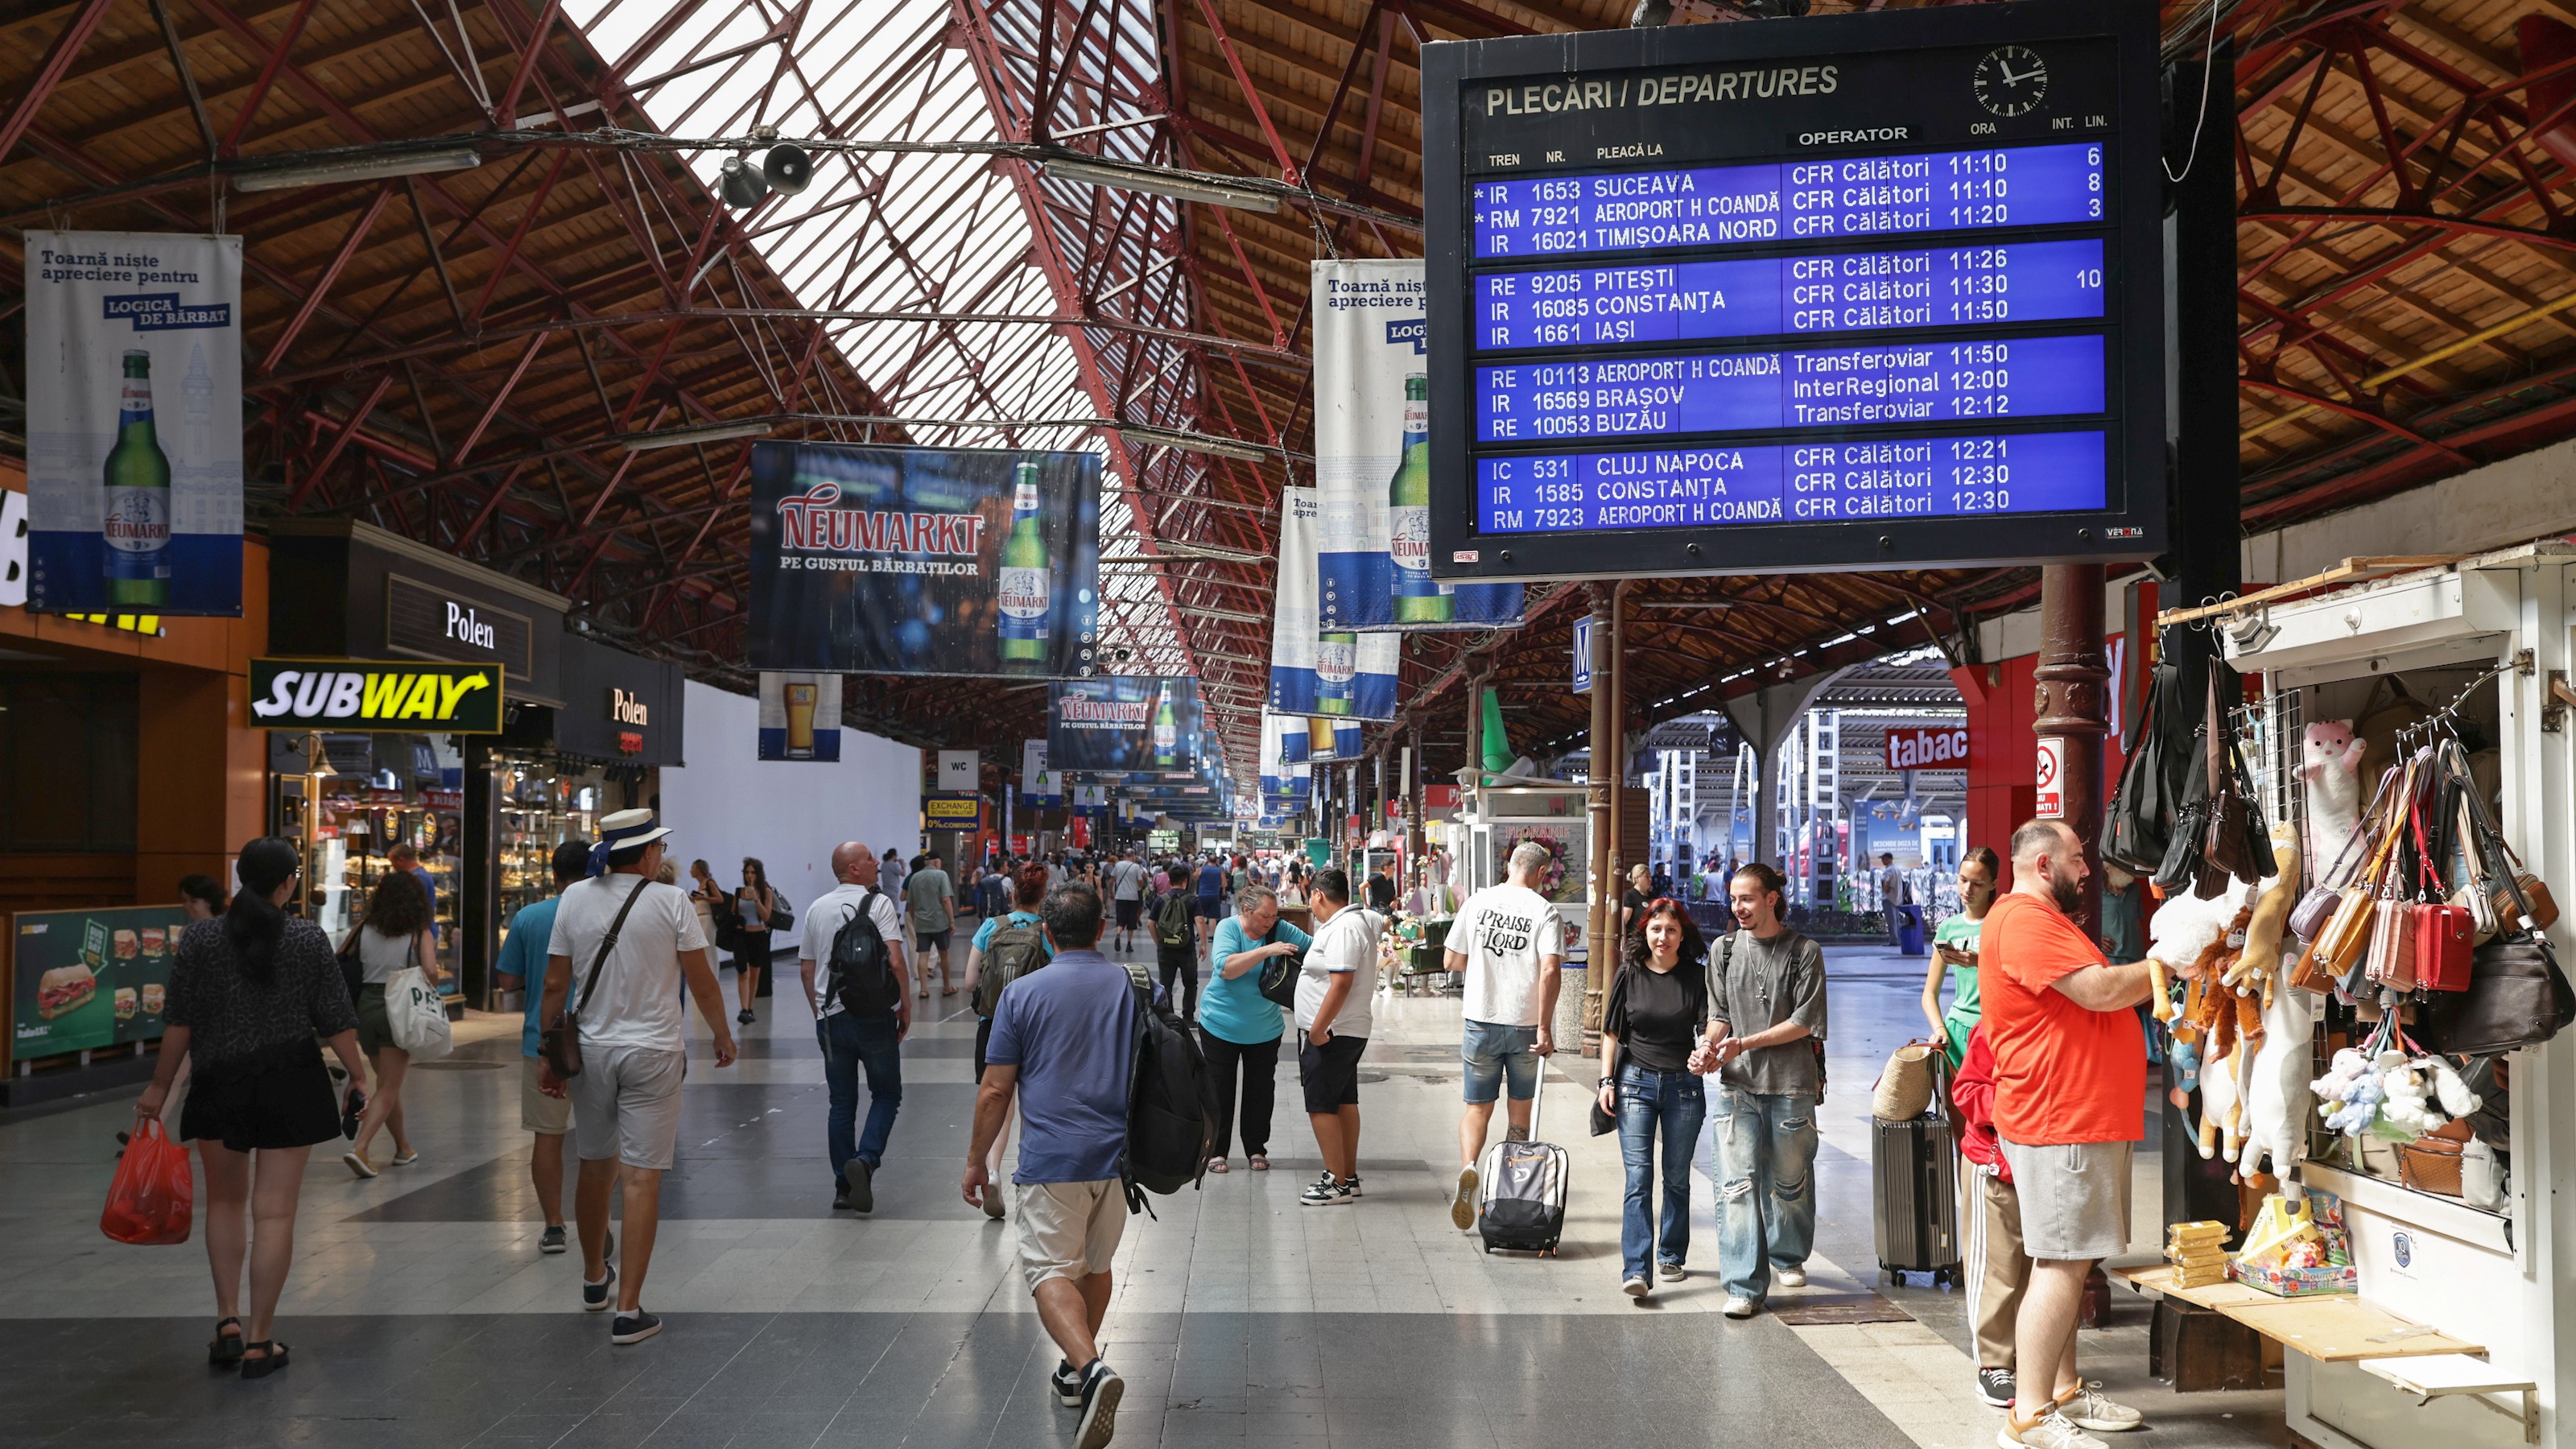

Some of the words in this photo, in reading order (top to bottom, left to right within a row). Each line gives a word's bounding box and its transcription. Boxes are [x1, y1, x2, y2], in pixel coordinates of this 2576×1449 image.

[1488, 76, 1611, 116] PLECĂRI
[1638, 66, 1838, 106] DEPARTURES
[1799, 126, 1908, 146] OPERATOR
[1971, 122, 1996, 134] ORA
[2052, 118, 2074, 130] INT.
[2085, 115, 2107, 127] LIN.
[1489, 154, 1520, 166] TREN
[1546, 151, 1566, 163] NR.
[1597, 142, 1644, 159] PLEACĂ
[1648, 143, 1663, 156] LA
[1490, 186, 1508, 204] IR
[1531, 180, 1581, 202] 1653
[1595, 174, 1695, 198] SUCEAVA
[1793, 164, 1834, 184] CFR
[1843, 158, 1930, 182] Călători
[1949, 153, 2007, 175] 11:10
[2087, 147, 2100, 166] 6
[1490, 210, 1520, 229] RM
[1531, 206, 1579, 227] 7921
[1595, 199, 1684, 222] AEROPORT
[1691, 198, 1701, 217] H
[1708, 192, 1780, 216] COANDĂ
[1793, 190, 1834, 210] CFR
[1843, 183, 1930, 207] Călători
[1950, 179, 2007, 200] 11:10
[2088, 172, 2100, 192] 8
[1491, 235, 1509, 254] IR
[1531, 229, 1587, 251] 16021
[1596, 222, 1711, 248] TIMIȘOARA
[1719, 218, 1777, 239] NORD
[1793, 215, 1835, 236] CFR
[1843, 208, 1930, 232] Călători
[1950, 204, 2008, 225] 11:20
[2088, 198, 2101, 217] 3
[41, 250, 108, 266] Toarnă
[114, 254, 159, 270] niște
[1491, 278, 1516, 296] RE
[1531, 274, 1581, 294] 9205
[1595, 268, 1674, 292] PITEȘTI
[1793, 259, 1834, 279] CFR
[1843, 252, 1930, 277] Călători
[1950, 249, 2007, 270] 11:26
[42, 267, 132, 283] apreciere
[137, 271, 199, 286] pentru
[1328, 279, 1390, 293] Toarnă
[1396, 279, 1426, 295] niș
[108, 299, 173, 313] LOGICA
[1329, 294, 1414, 311] apreciere
[1491, 303, 1509, 320] IR
[1532, 298, 1589, 319] 16085
[1596, 291, 1726, 316] CONSTANȚA
[1794, 284, 1835, 304] CFR
[1843, 277, 1930, 302] Călători
[1950, 274, 2008, 295] 11:30
[2076, 269, 2101, 289] 10
[140, 313, 163, 325] DE
[167, 309, 226, 324] BĂRBAT
[1391, 324, 1426, 338] LOG
[1492, 327, 1509, 345] IR
[1533, 324, 1580, 343] 1661
[1596, 320, 1635, 342] IAȘI
[1794, 309, 1835, 329] CFR
[1844, 303, 1930, 327] Călători
[1951, 299, 2008, 321] 11:50
[1492, 369, 1517, 388] RE
[1532, 365, 1589, 386] 10113
[1596, 361, 1685, 383] AEROPORT
[1692, 360, 1702, 378] H
[1709, 353, 1781, 378] COANDĂ
[1794, 348, 1933, 374] Transferoviar
[1951, 344, 2008, 365] 11:50
[1492, 394, 1509, 413] IR
[1533, 390, 1589, 411] 16569
[1596, 385, 1685, 408] BRAȘOV
[1794, 373, 1939, 398] InterRegional
[1951, 369, 2008, 390] 12:00
[1492, 419, 1517, 437] RE
[1533, 415, 1590, 436] 10053
[1596, 407, 1666, 432] BUZĂU
[1794, 398, 1934, 423] Transferoviar
[1951, 394, 2008, 416] 12:12
[1493, 461, 1511, 481] IC
[1534, 459, 1569, 478] 531
[1597, 455, 1647, 476] CLUJ
[1656, 452, 1744, 473] NAPOCA
[1794, 447, 1835, 467] CFR
[1844, 442, 1930, 465] Călători
[1951, 439, 2007, 460] 12:21
[1493, 486, 1511, 505] IR
[1535, 483, 1583, 503] 1585
[1597, 477, 1727, 501] CONSTANȚA
[1794, 473, 1835, 492] CFR
[1845, 467, 1931, 490] Călători
[1951, 464, 2009, 485] 12:30
[777, 481, 984, 555] NEUMARKT
[1493, 510, 1522, 529] RM
[1534, 507, 1583, 527] 7923
[1598, 503, 1686, 525] AEROPORT
[1694, 503, 1703, 521] H
[1711, 497, 1782, 520] COANDĂ
[1795, 497, 1836, 517] CFR
[1845, 492, 1931, 515] Călători
[1951, 489, 2009, 511] 12:30
[1392, 532, 1430, 557] NEUMA
[780, 556, 801, 568] PE
[805, 556, 869, 572] GUSTUL
[872, 557, 978, 576] BĂRBAȚILOR
[1000, 588, 1048, 608] NEUMARKT
[446, 601, 494, 649] Polen
[1577, 625, 1589, 674] M
[252, 671, 489, 720] SUBWAY
[613, 688, 647, 725] Polen
[1059, 690, 1149, 721] NEUMARKT
[1100, 722, 1146, 730] BĂRBAȚILOR
[1889, 730, 1968, 769] tabac
[952, 762, 967, 771] WC
[931, 802, 973, 810] EXCHANGE
[1505, 824, 1571, 839] FLORĂRIE
